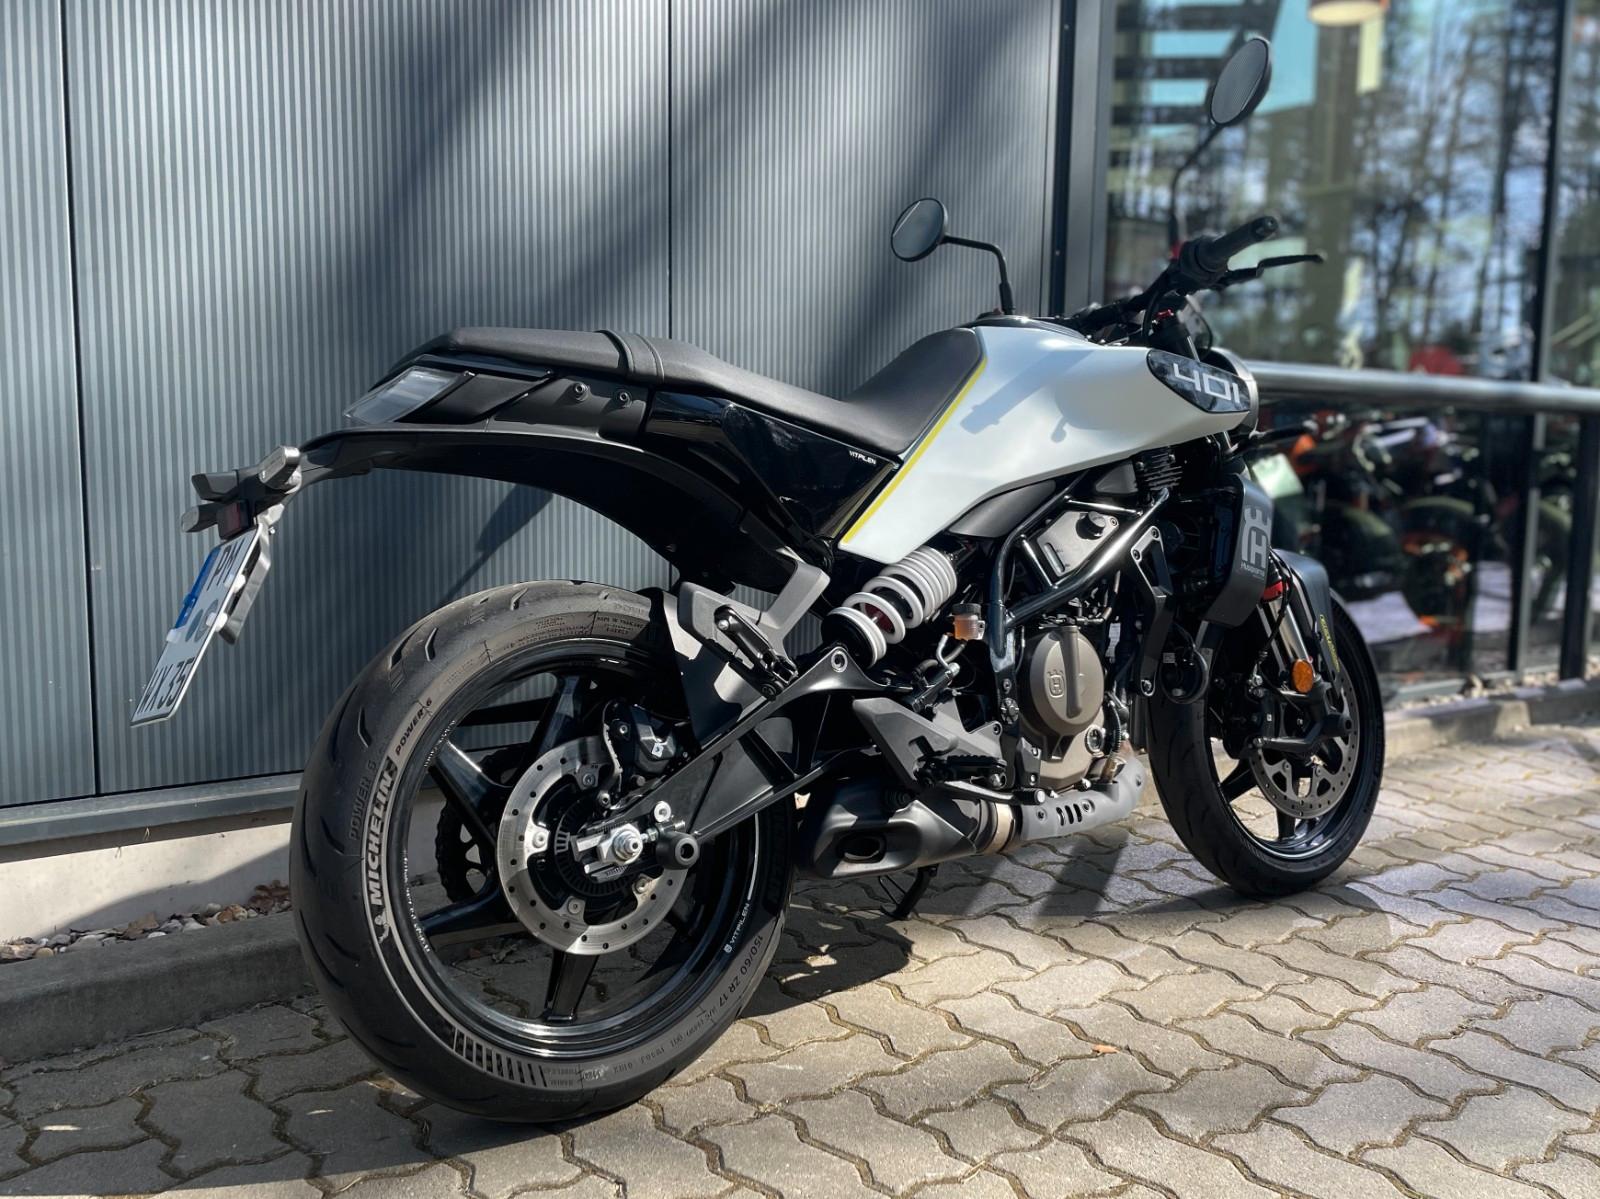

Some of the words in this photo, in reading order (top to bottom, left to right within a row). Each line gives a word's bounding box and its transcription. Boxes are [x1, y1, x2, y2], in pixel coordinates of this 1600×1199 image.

[1172, 362, 1241, 404] 401
[206, 537, 246, 591] PM
[157, 656, 196, 710] 35
[394, 709, 424, 757] POWER
[424, 697, 433, 708] 6
[349, 778, 372, 842] POWER
[365, 772, 396, 906] MICHELIN
[740, 934, 763, 976] 150/60
[718, 995, 729, 1008] 17
[727, 977, 742, 993] ZR
